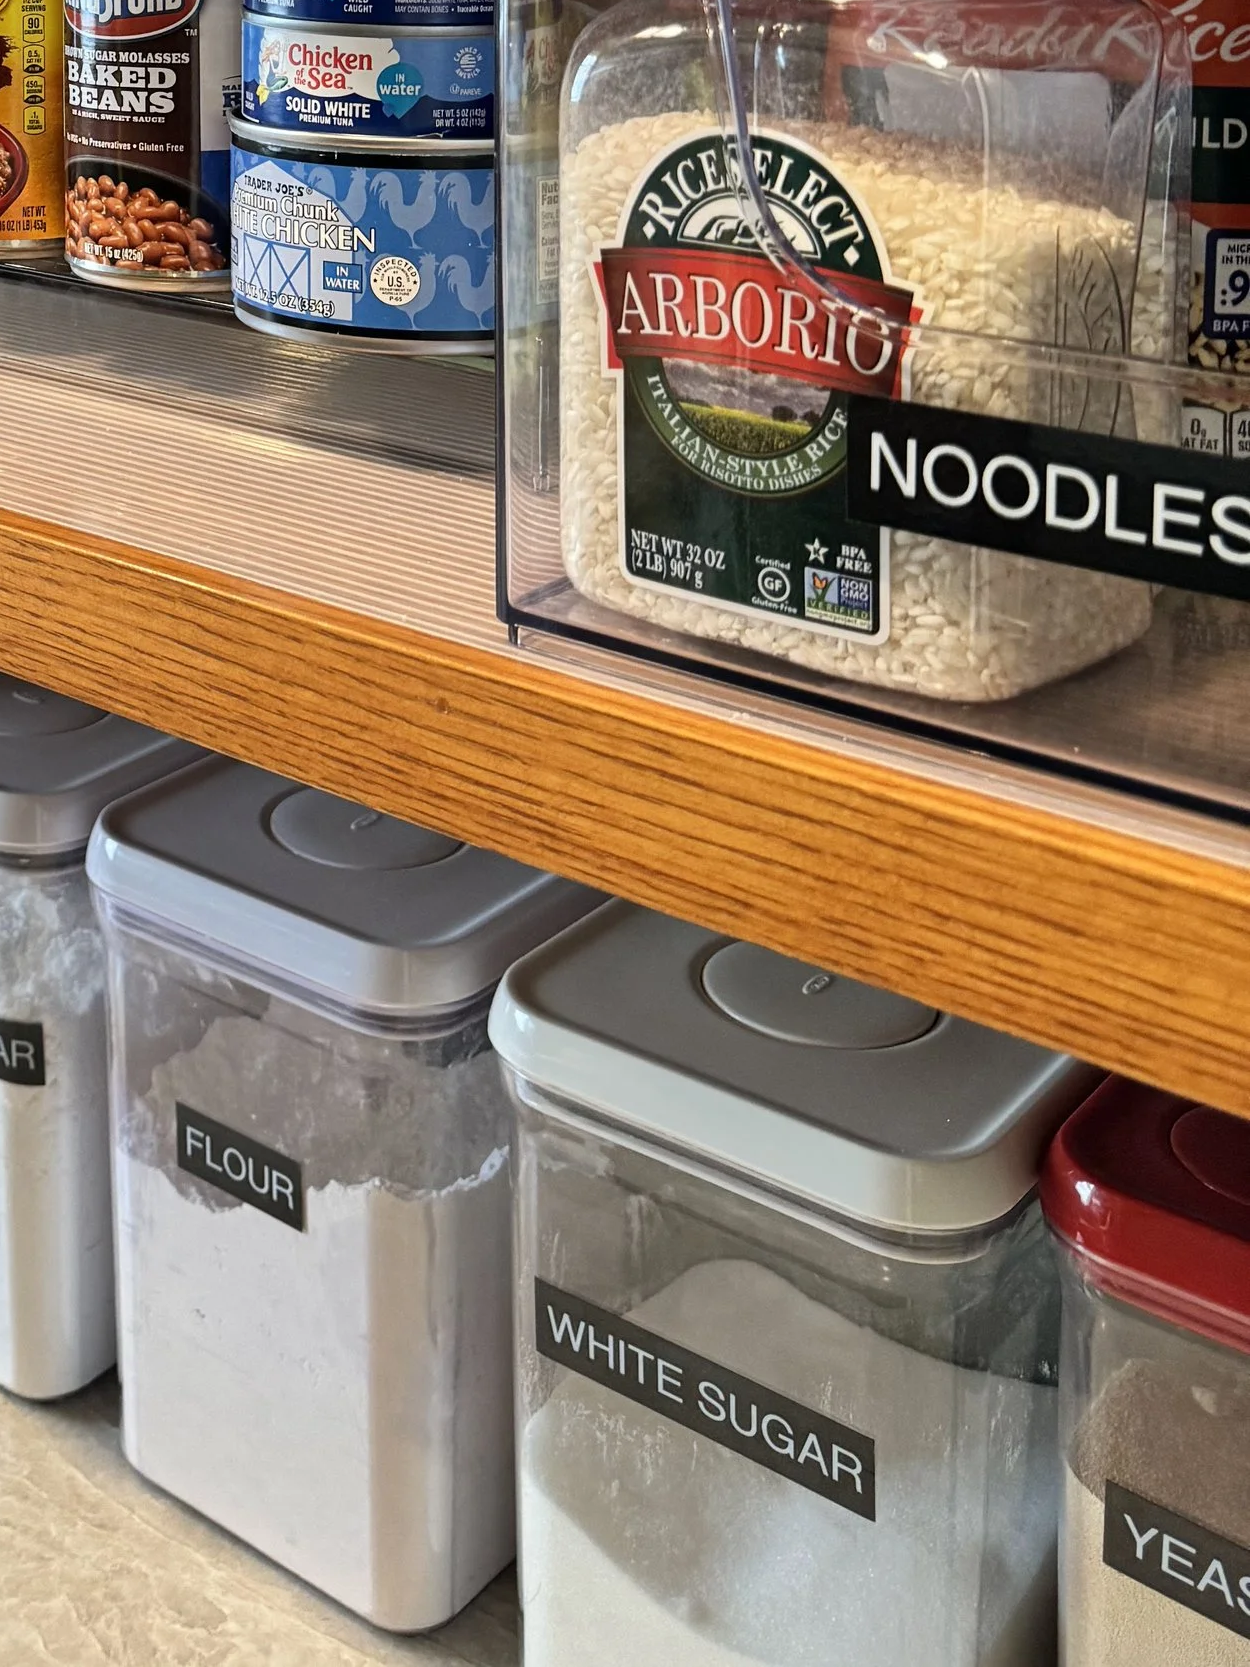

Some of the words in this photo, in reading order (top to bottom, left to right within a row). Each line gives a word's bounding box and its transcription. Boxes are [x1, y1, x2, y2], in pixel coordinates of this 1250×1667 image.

[21, 3, 47, 13] SERVING
[343, 4, 374, 14] CAUGHT
[27, 17, 41, 30] 90
[83, 47, 118, 64] SUGAR
[118, 50, 190, 65] MOLASSES
[287, 42, 374, 76] Chicken
[66, 59, 178, 90] BAKED
[307, 67, 347, 91] Sea
[67, 82, 176, 115] BEANS
[378, 81, 423, 97] water
[284, 94, 322, 116] SOLID
[323, 98, 372, 120] WHITE
[99, 112, 132, 124] SWEET
[132, 115, 167, 125] SAUCE
[297, 112, 333, 127] PREMIUM
[331, 115, 355, 128] TUNA
[88, 136, 132, 152] Preservatives
[138, 141, 165, 153] Gluten
[165, 142, 185, 153] Free
[243, 174, 274, 193] TRADER
[274, 182, 305, 198] JOE'S
[637, 139, 866, 249] RICEELECT
[22, 206, 35, 219] NET
[234, 182, 278, 214] Premium
[280, 195, 340, 224] Chunk
[260, 214, 377, 254] CHICKEN
[335, 265, 350, 278] IN
[373, 258, 418, 278] INSPECTED
[324, 276, 361, 291] WATER
[386, 275, 406, 288] U.S.
[278, 293, 297, 308] OZ
[296, 295, 336, 319] (354g)
[616, 270, 894, 377] ARBORIO
[1212, 318, 1240, 334] BPA
[646, 374, 804, 477] ITALIAN-STYLE
[807, 406, 850, 464] RICE
[1199, 437, 1220, 452] FAT
[670, 436, 698, 467] FOR
[699, 458, 766, 492] RISOTTO
[767, 462, 823, 492] DISHES
[869, 430, 1250, 567] NOODLES
[630, 527, 659, 553] NET
[660, 535, 684, 560] WT
[685, 541, 702, 564] 32
[703, 547, 727, 572] OZ
[840, 543, 868, 561] BPA
[644, 551, 668, 581] LB)
[669, 559, 693, 582] 907
[754, 554, 792, 572] Certified
[835, 555, 873, 575] FREE
[838, 587, 870, 602] GMO
[839, 577, 869, 594] NON
[750, 595, 798, 615] Gluten-Free
[806, 598, 870, 620] VERIFIED
[184, 1122, 297, 1213] FLOUR
[545, 1303, 684, 1404] WHITE
[695, 1379, 865, 1496] SUGAR
